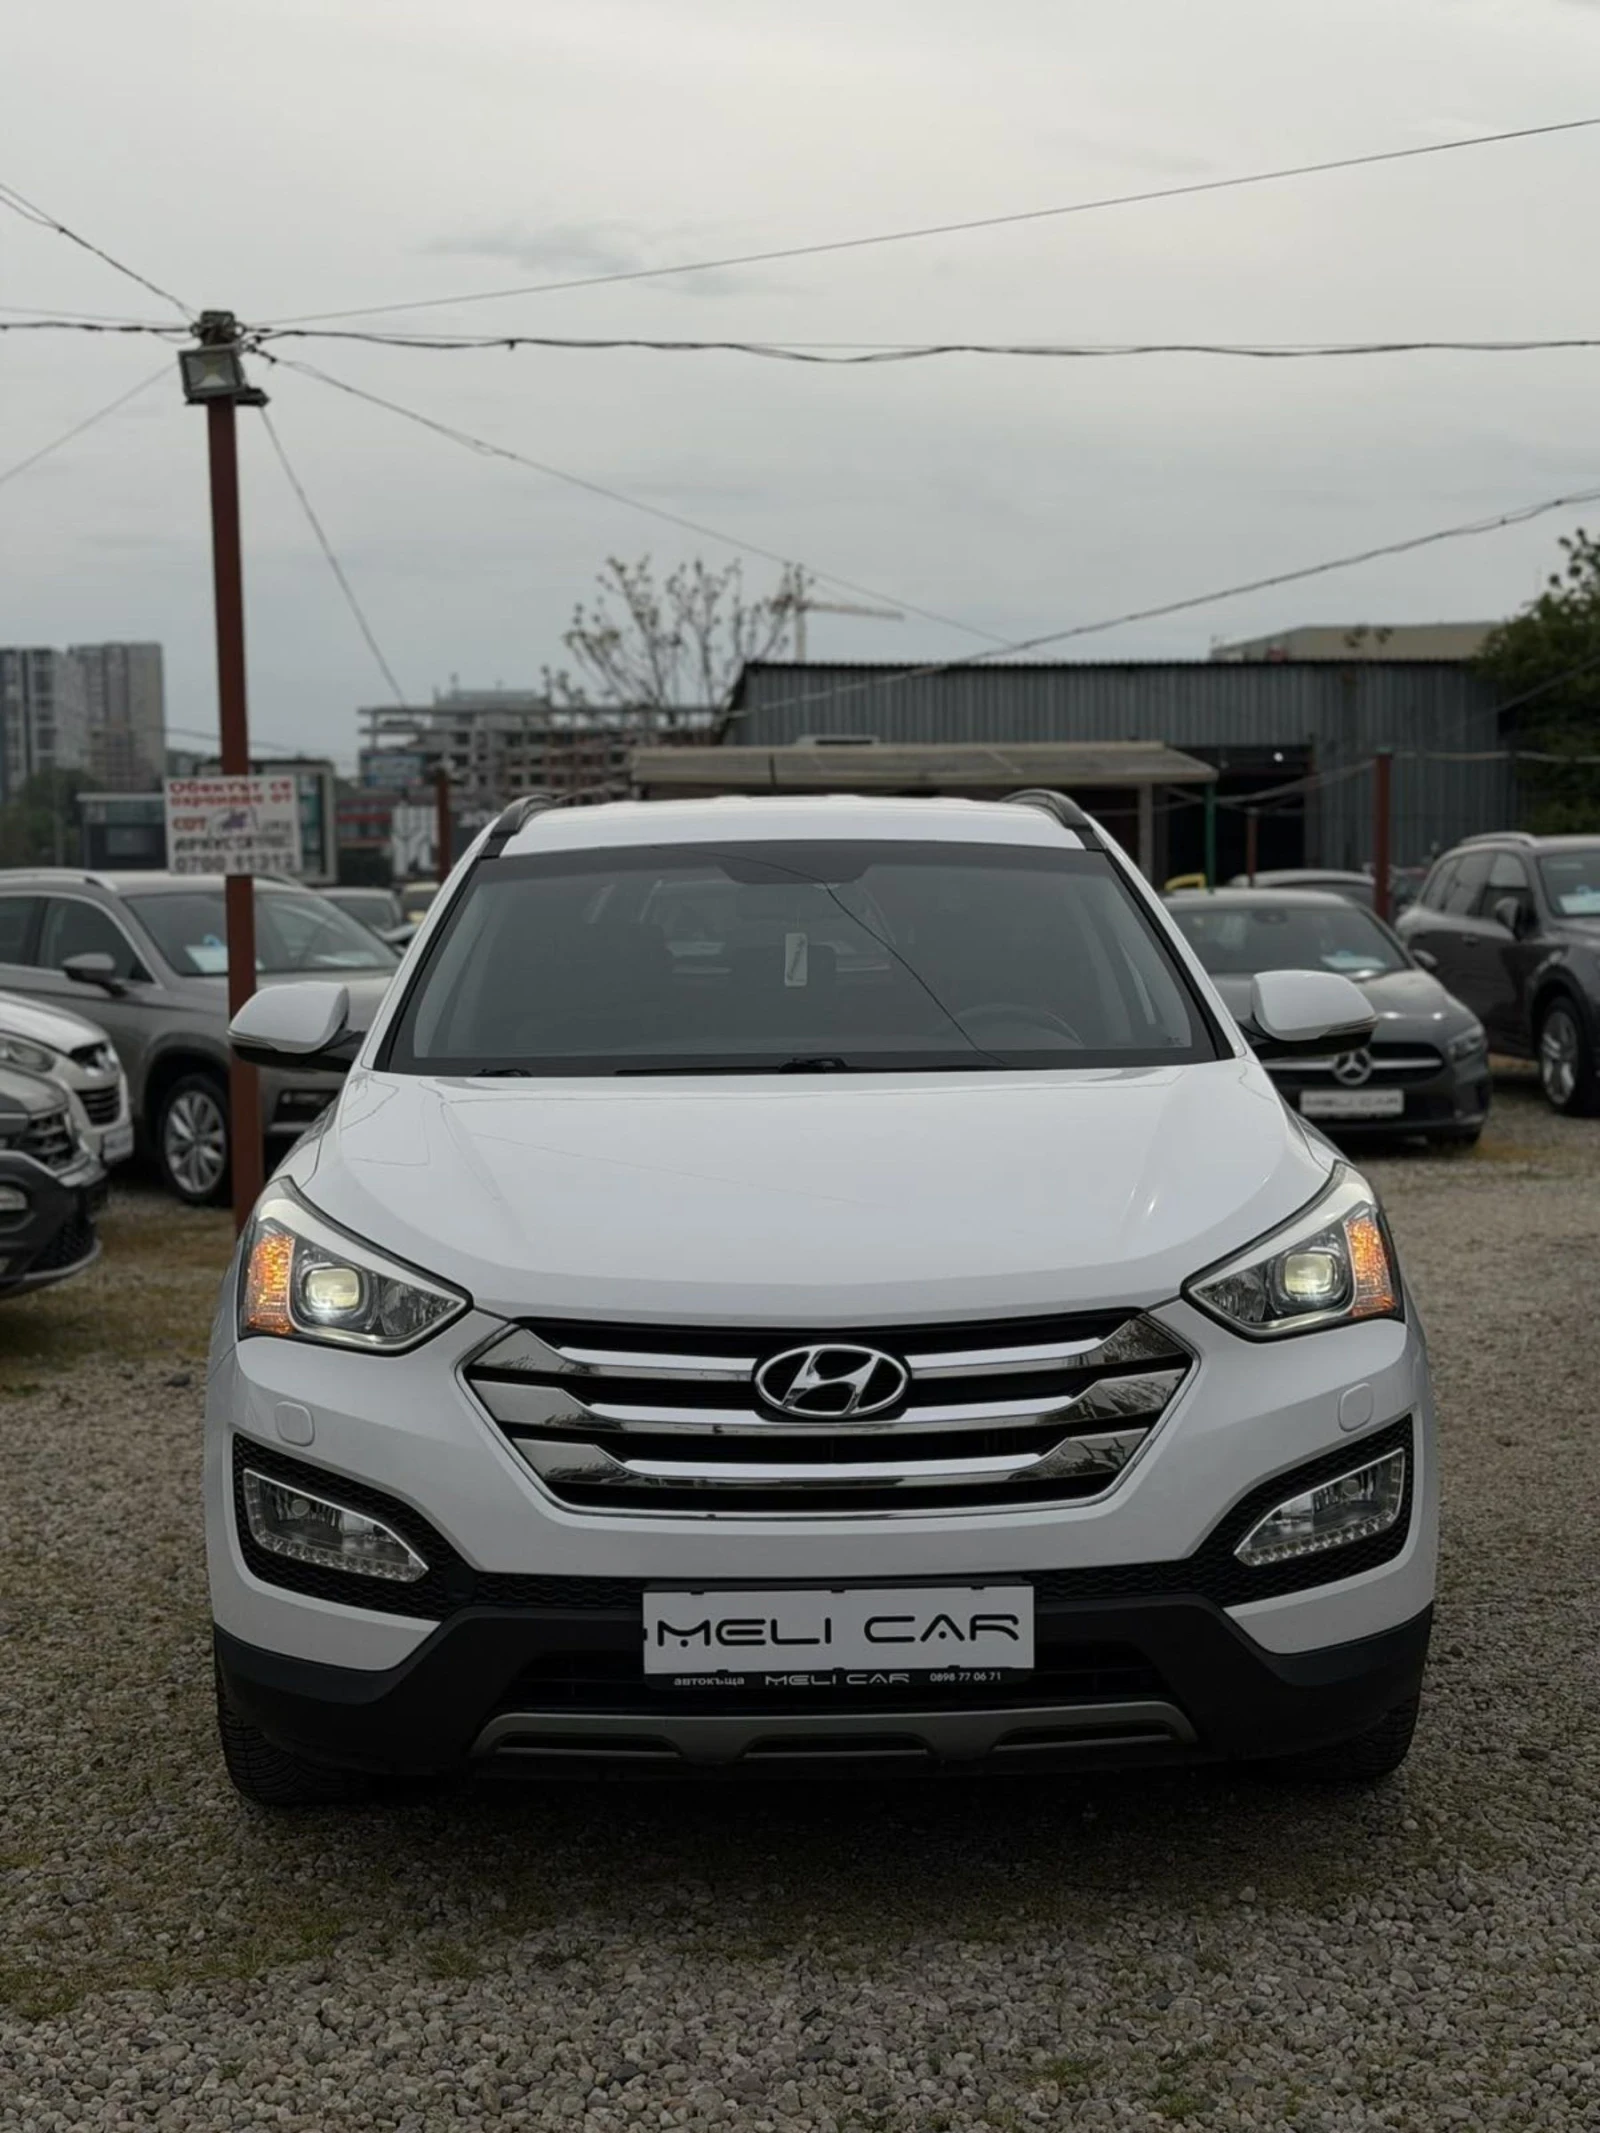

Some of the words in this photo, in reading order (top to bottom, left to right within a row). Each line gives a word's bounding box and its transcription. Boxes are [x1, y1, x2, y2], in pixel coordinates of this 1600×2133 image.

[657, 1617, 832, 1648] MELI
[864, 1613, 1020, 1643] CAR
[674, 1676, 745, 1687] автокъща
[765, 1673, 837, 1686] MELI
[846, 1673, 910, 1685] CAR
[929, 1672, 956, 1682] 0898
[958, 1672, 971, 1682] 77
[973, 1671, 987, 1681] 06
[989, 1671, 1001, 1681] 71
